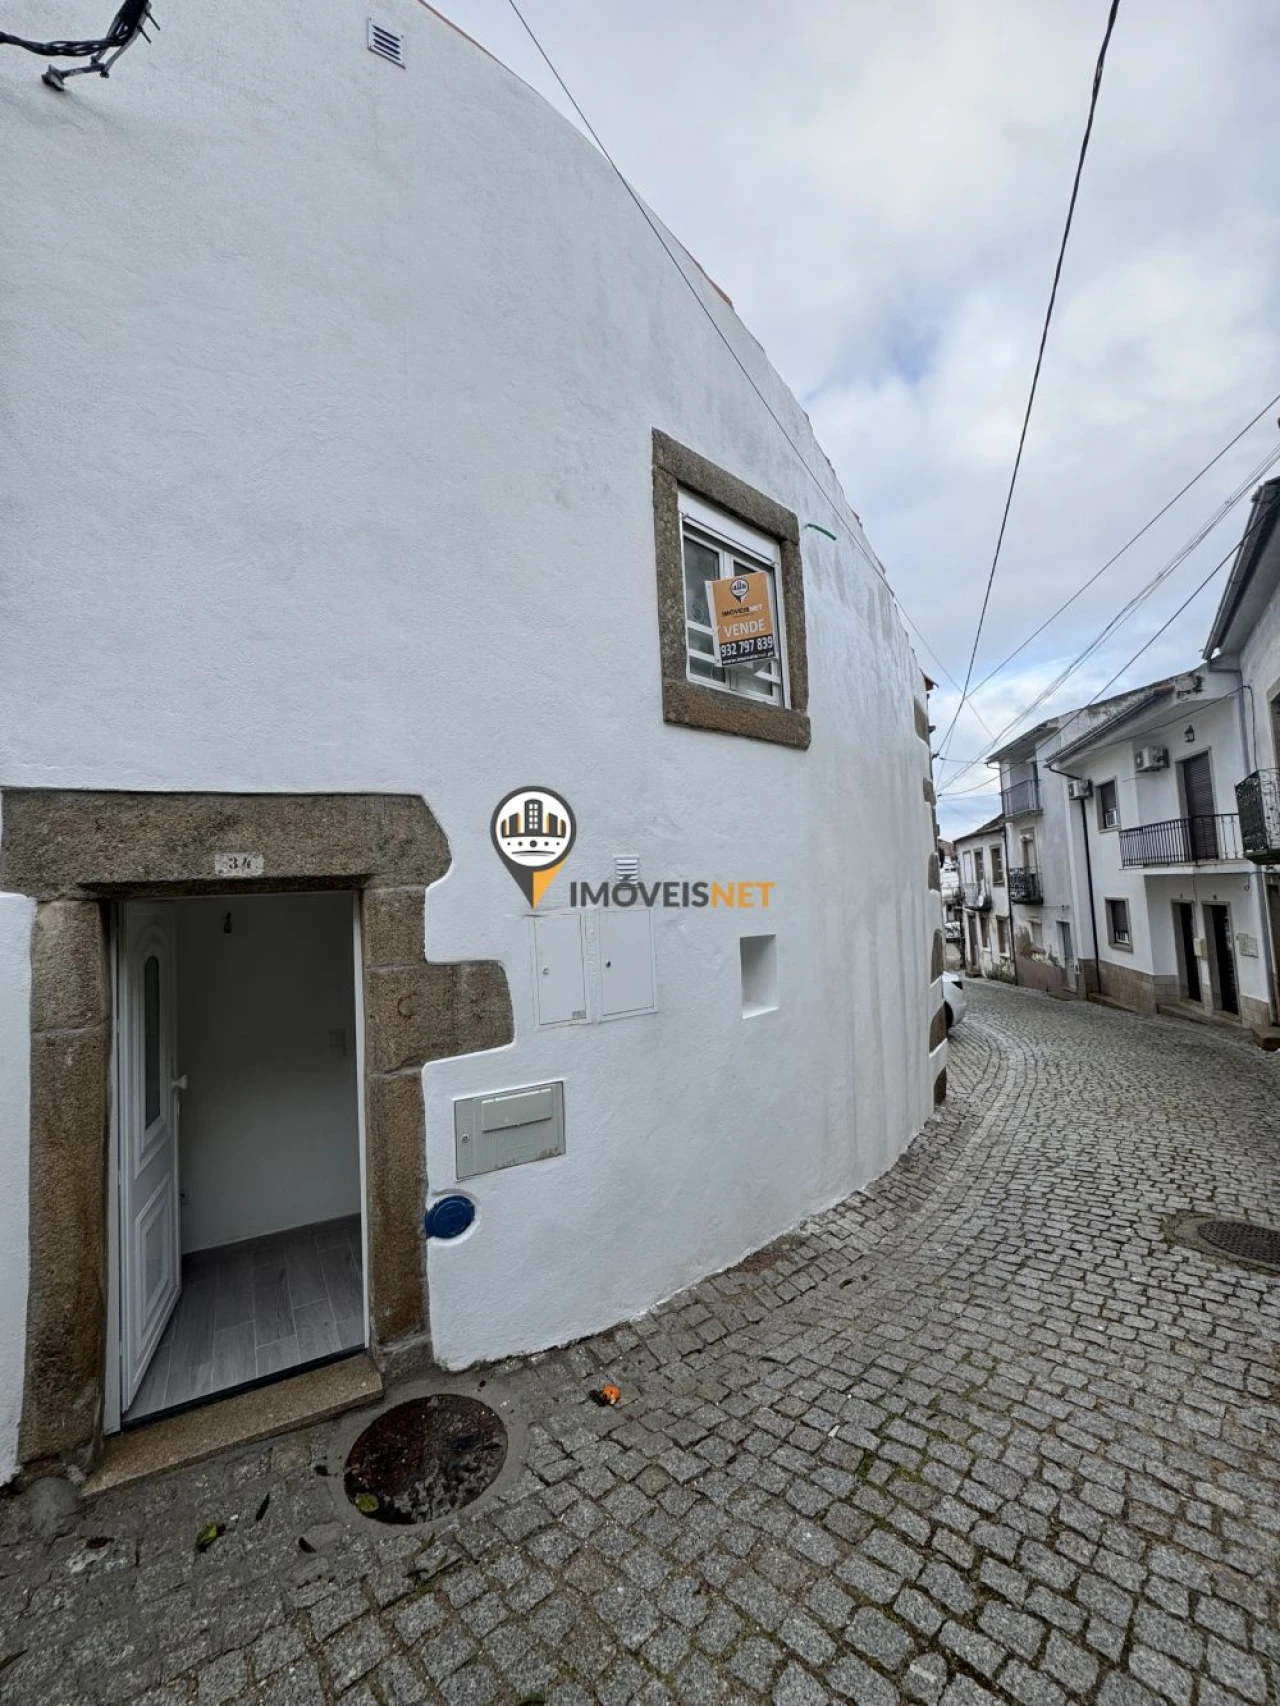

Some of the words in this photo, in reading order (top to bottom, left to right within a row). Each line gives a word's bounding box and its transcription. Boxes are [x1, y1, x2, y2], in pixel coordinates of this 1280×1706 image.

[723, 619, 766, 637] VENDE
[721, 643, 737, 657] 932
[739, 639, 755, 653] 797
[757, 635, 773, 650] 839
